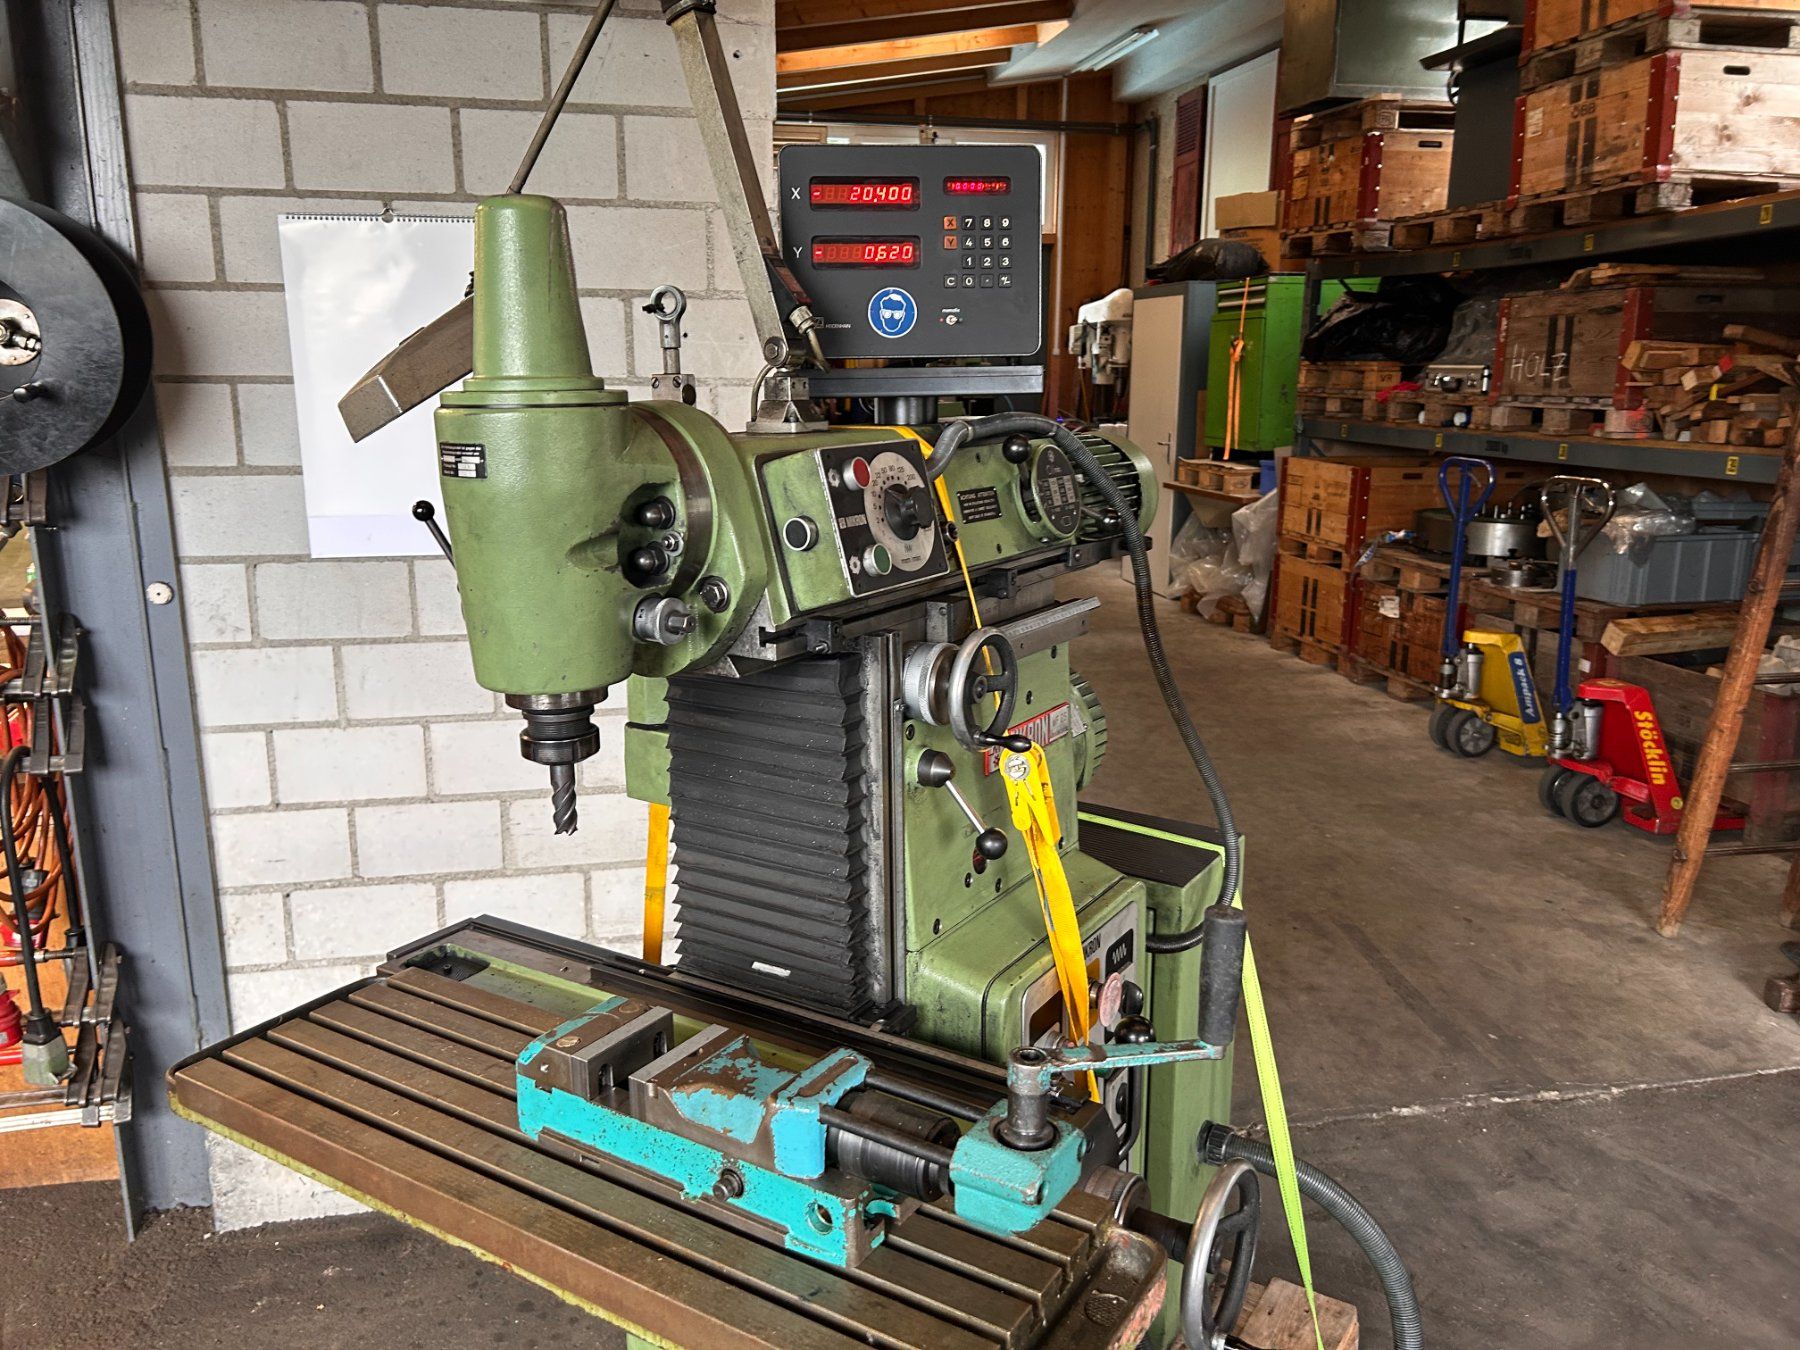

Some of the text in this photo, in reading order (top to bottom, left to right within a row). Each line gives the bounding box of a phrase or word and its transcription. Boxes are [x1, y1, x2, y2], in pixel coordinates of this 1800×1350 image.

[791, 187, 801, 200] X
[947, 218, 1010, 228] X 7 8 9
[946, 237, 1010, 247] Y 4 5 6
[793, 246, 803, 259] Y
[966, 257, 1010, 266] 1 2 3
[946, 277, 955, 286] C
[1510, 343, 1567, 382] HOLZ
[906, 473, 916, 481] 200
[1633, 710, 1669, 785] Stöcklin
